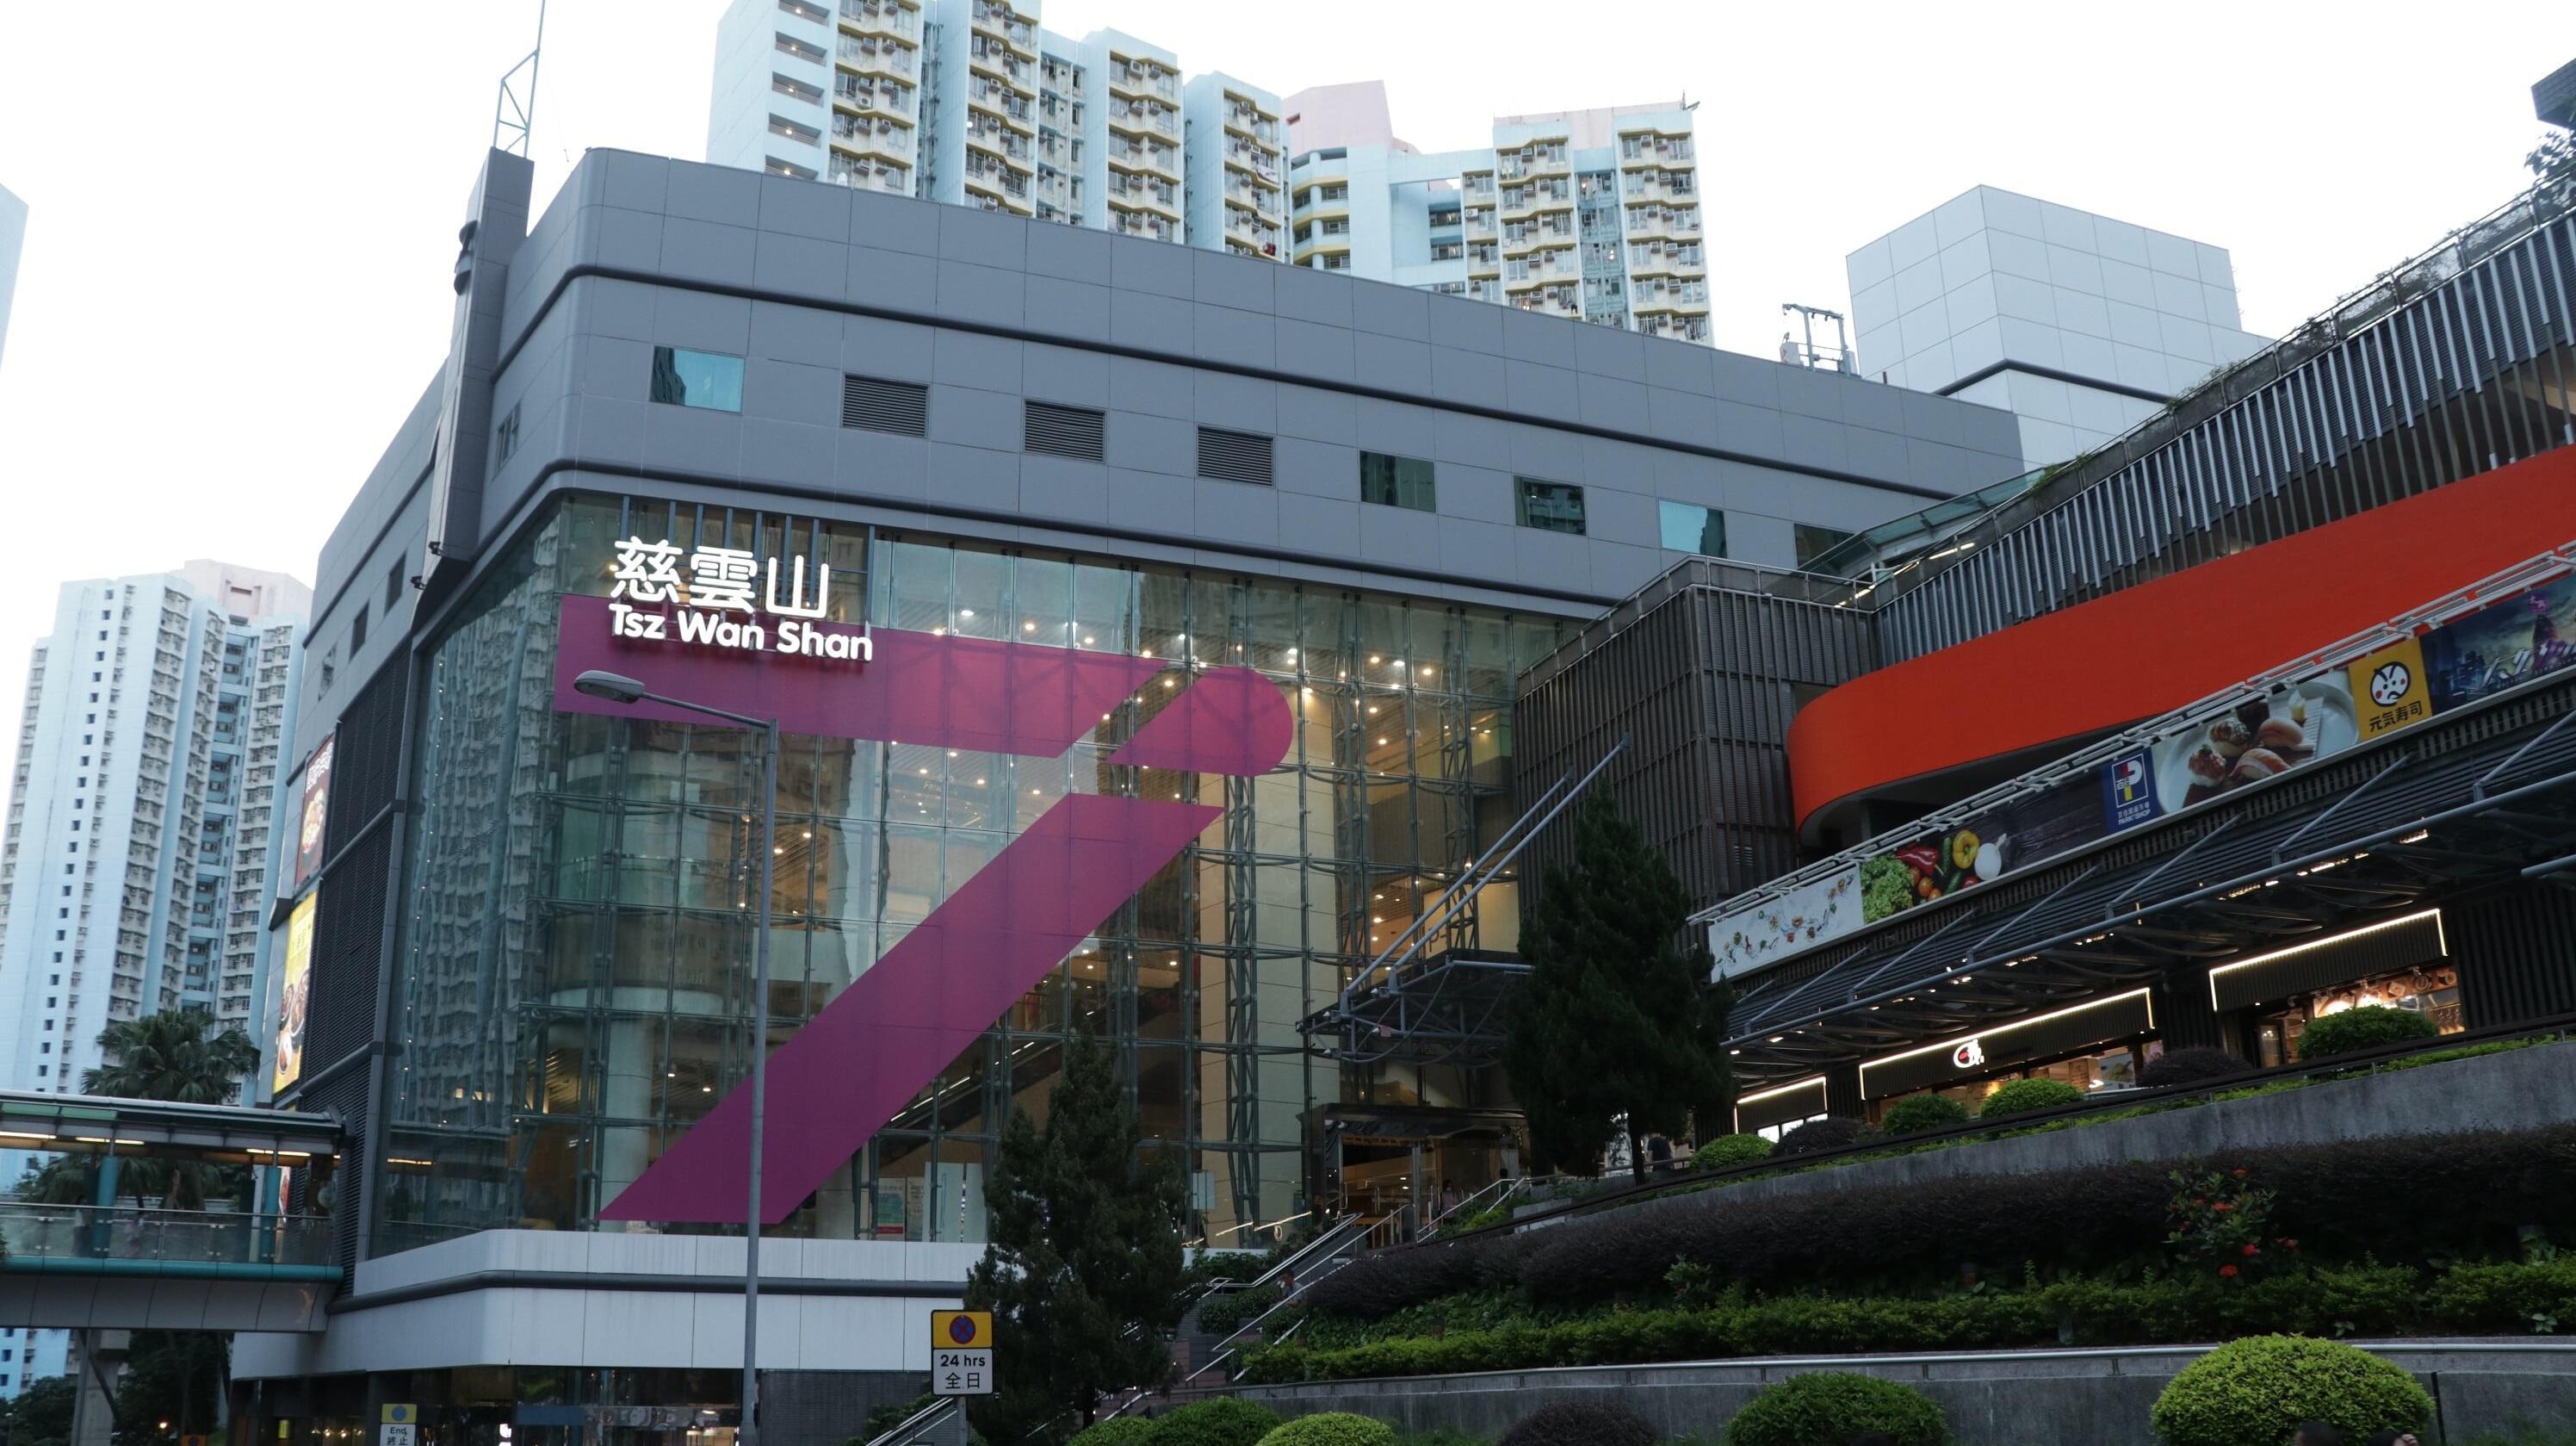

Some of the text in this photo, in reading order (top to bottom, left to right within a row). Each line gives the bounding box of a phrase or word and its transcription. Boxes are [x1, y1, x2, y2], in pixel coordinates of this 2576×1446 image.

[610, 535, 830, 619] 慈雲山
[608, 603, 874, 662] Tsz Wan Shan
[2369, 700, 2424, 733] 元気寿司
[940, 1354, 986, 1368] 24 hrs
[945, 1372, 981, 1390] 全日
